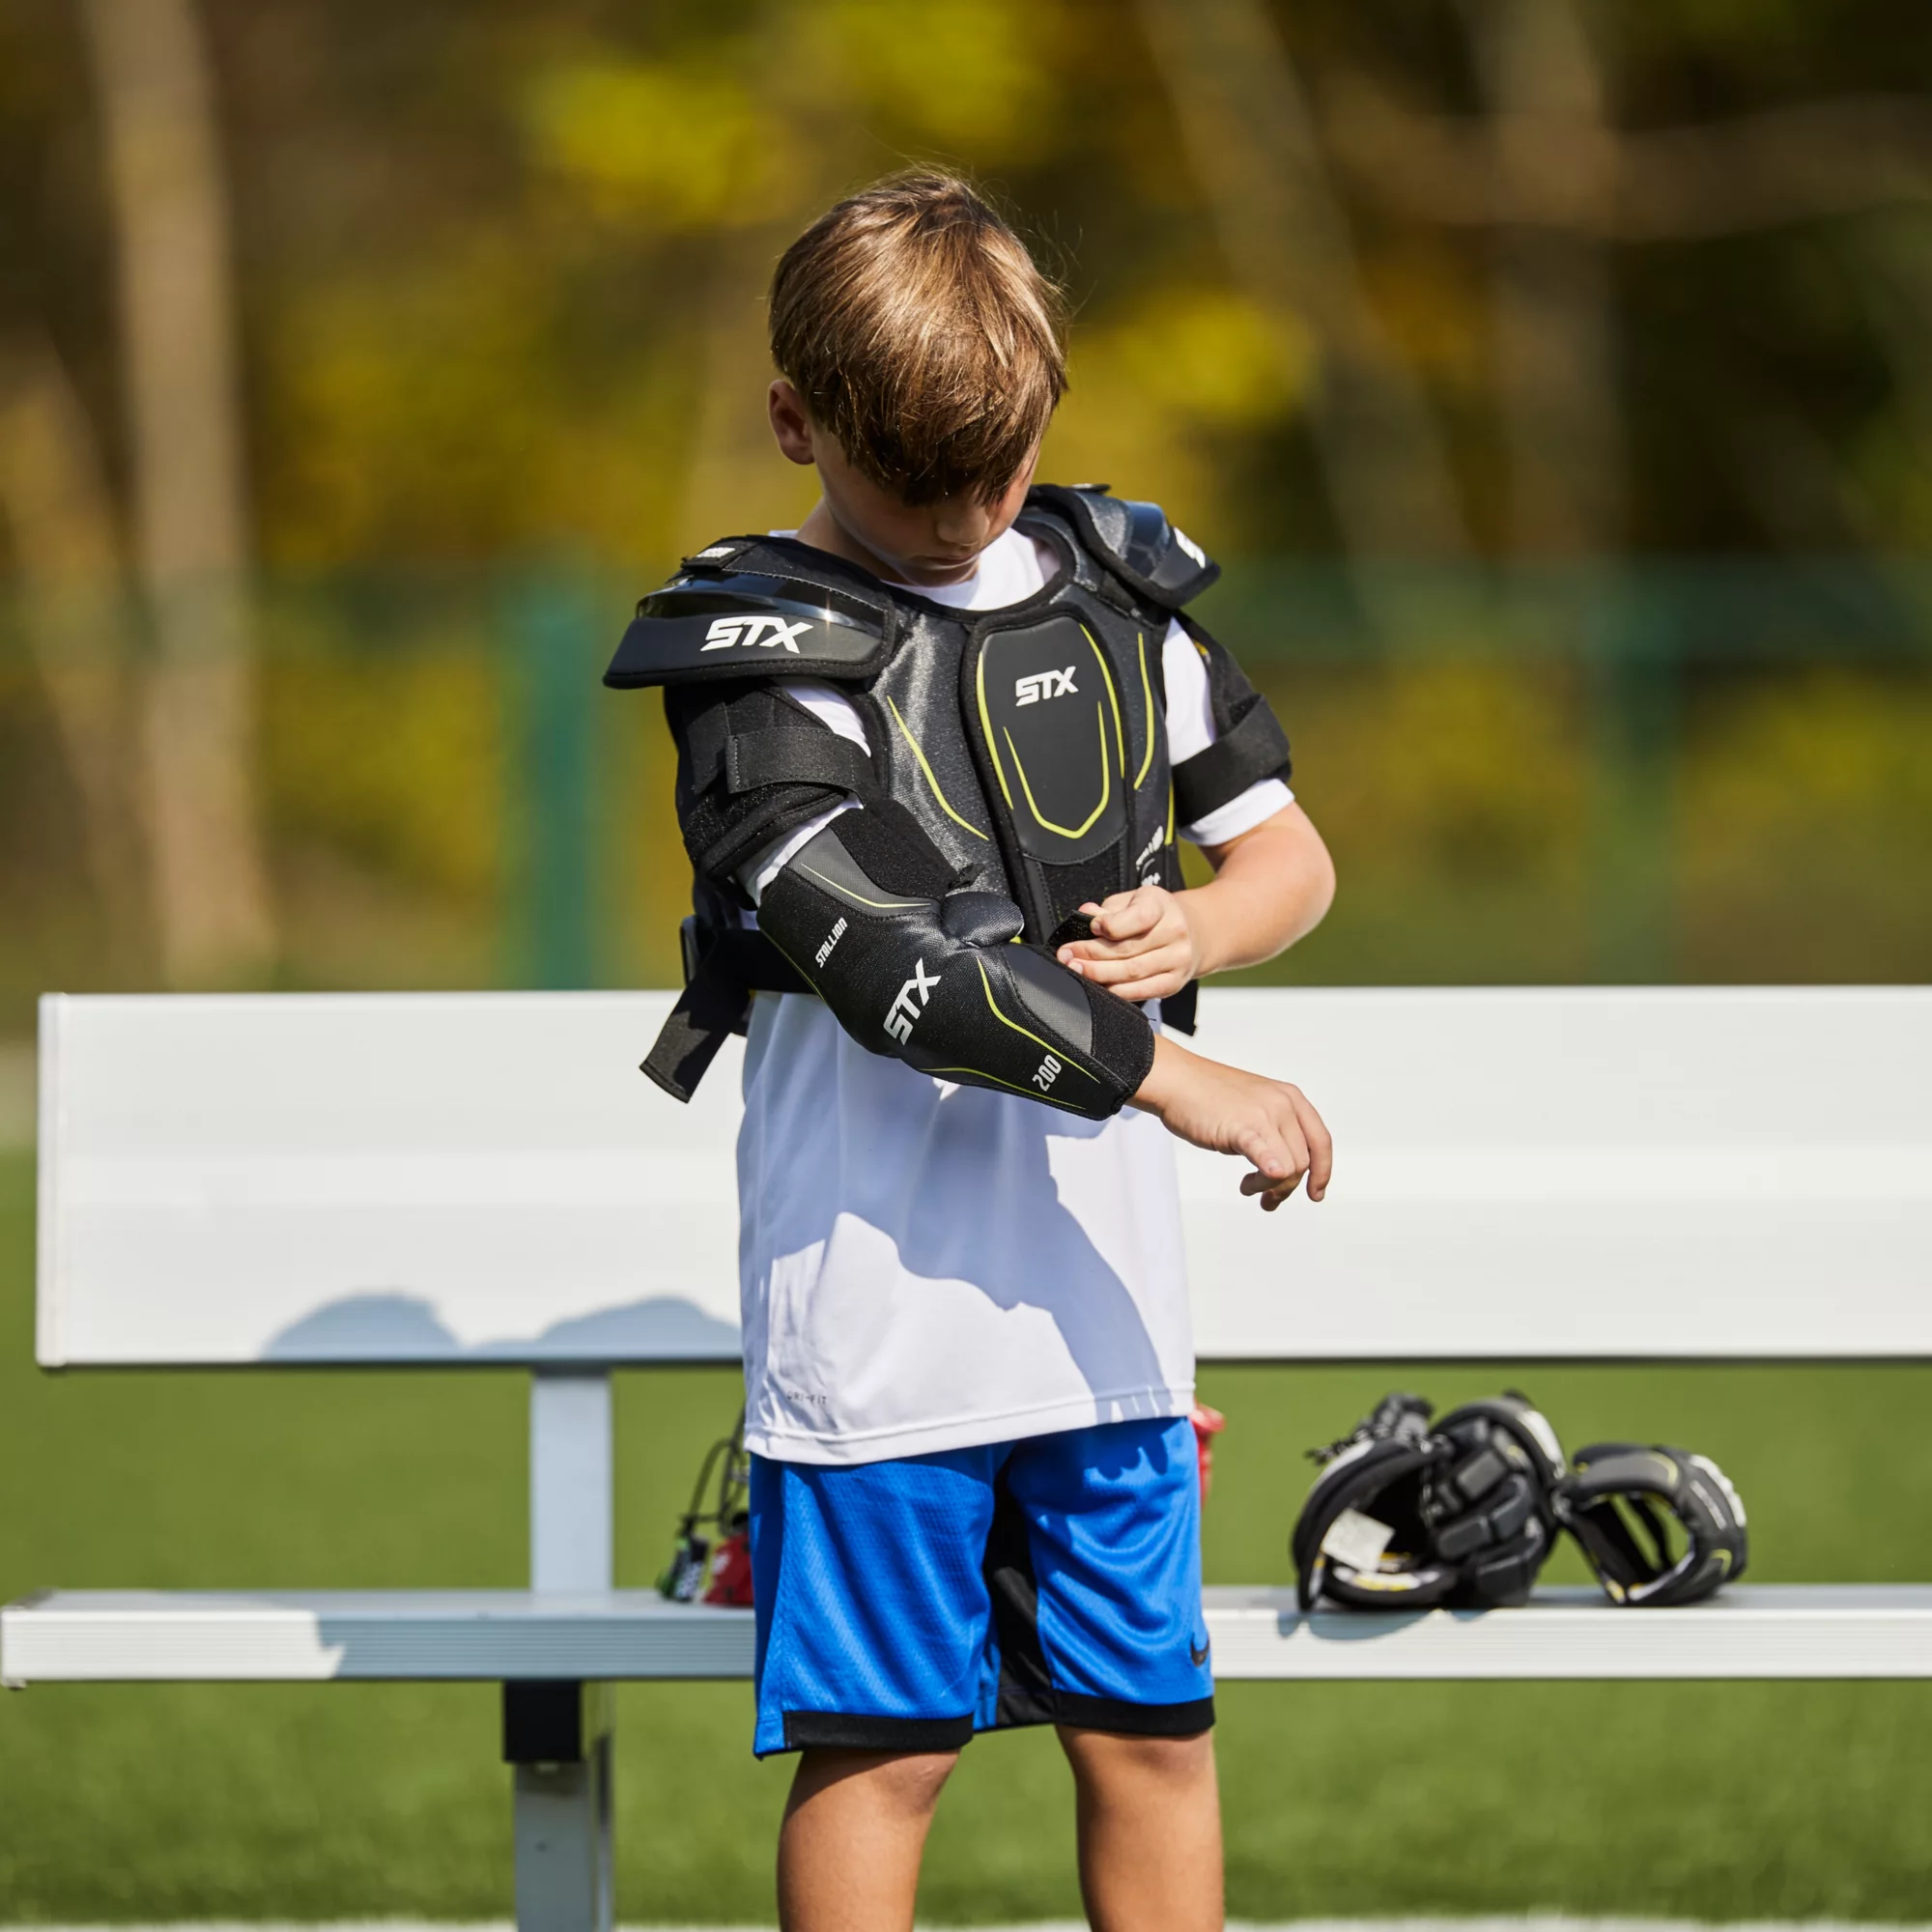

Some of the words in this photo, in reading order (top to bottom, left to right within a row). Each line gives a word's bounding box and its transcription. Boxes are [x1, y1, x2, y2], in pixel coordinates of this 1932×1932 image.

[699, 615, 813, 655] STX
[1015, 666, 1079, 707] STX
[814, 917, 848, 969] STALLION
[883, 957, 942, 1046] STX
[1032, 1054, 1062, 1092] 200
